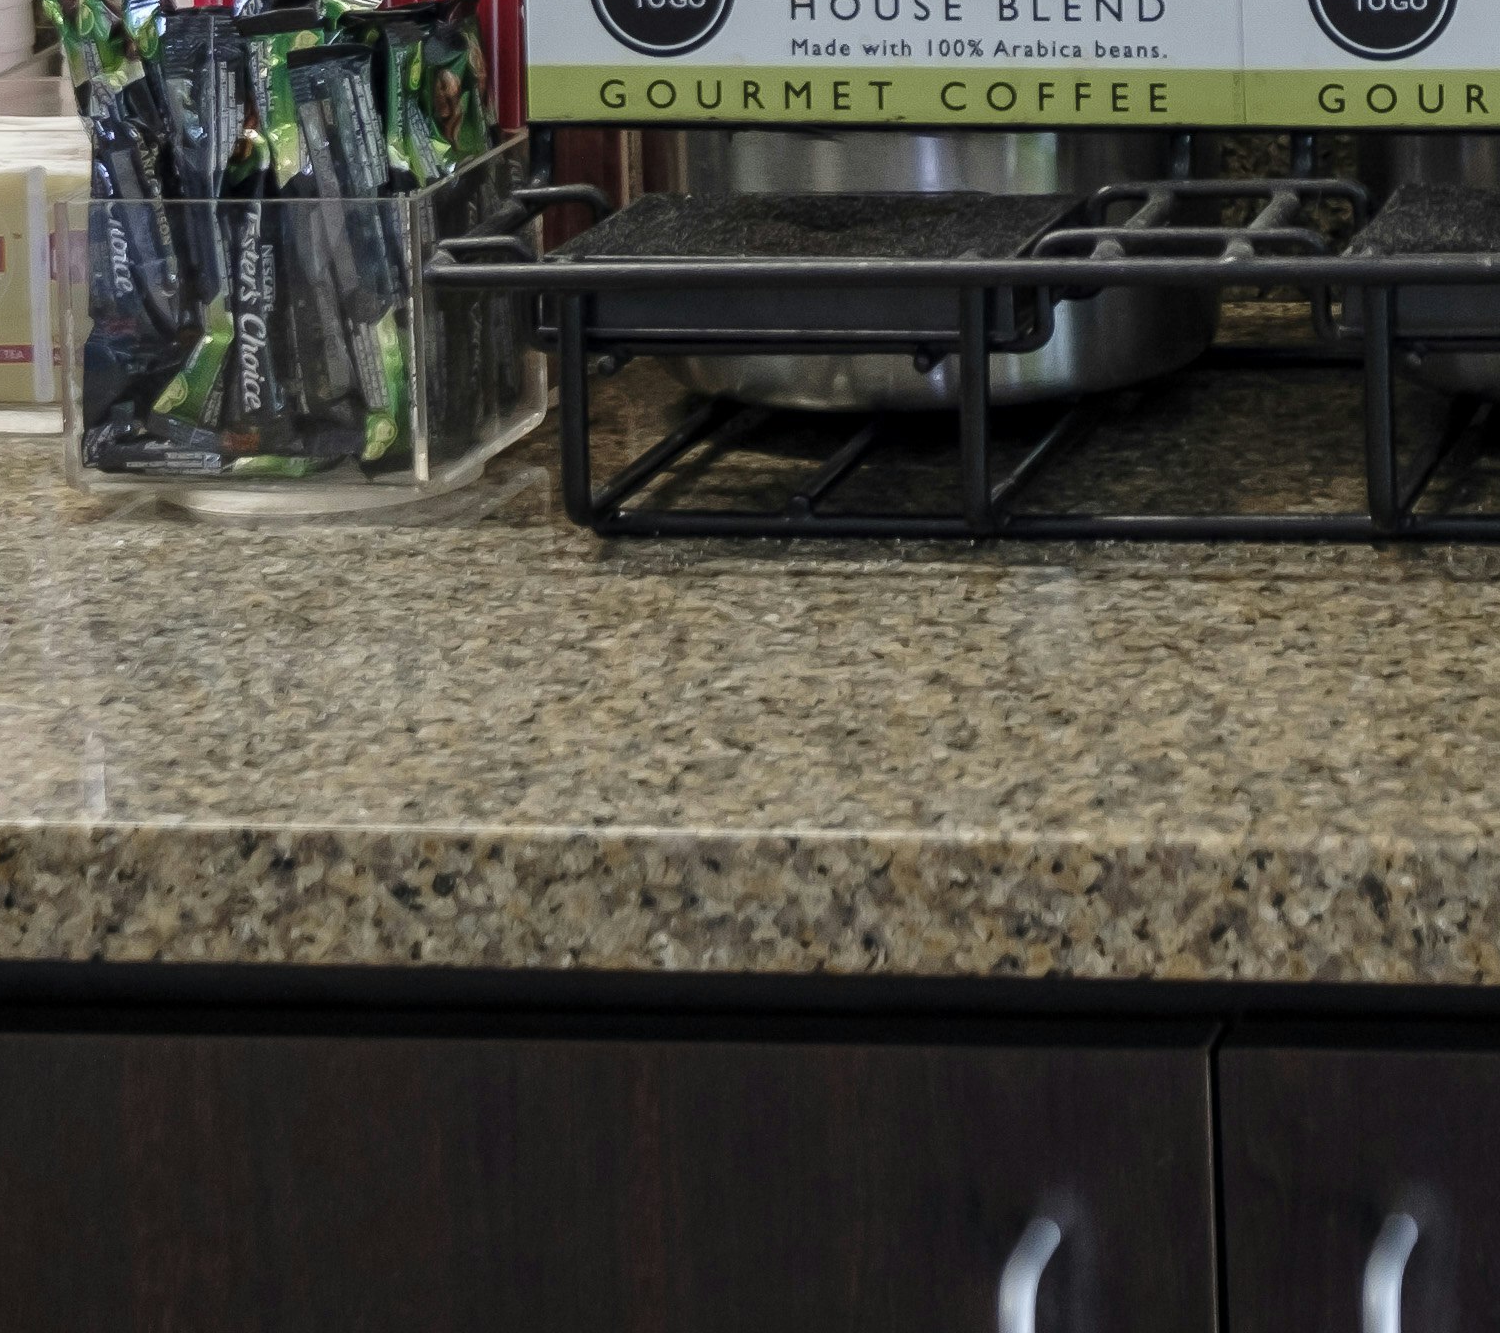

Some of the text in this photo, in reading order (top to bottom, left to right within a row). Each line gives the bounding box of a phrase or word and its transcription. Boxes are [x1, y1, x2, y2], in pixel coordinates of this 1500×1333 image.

[791, 38, 1169, 59] Made with 100% Arabica beans.
[599, 78, 1170, 113] GOURMET COFFEE
[2, 349, 25, 360] TEA
